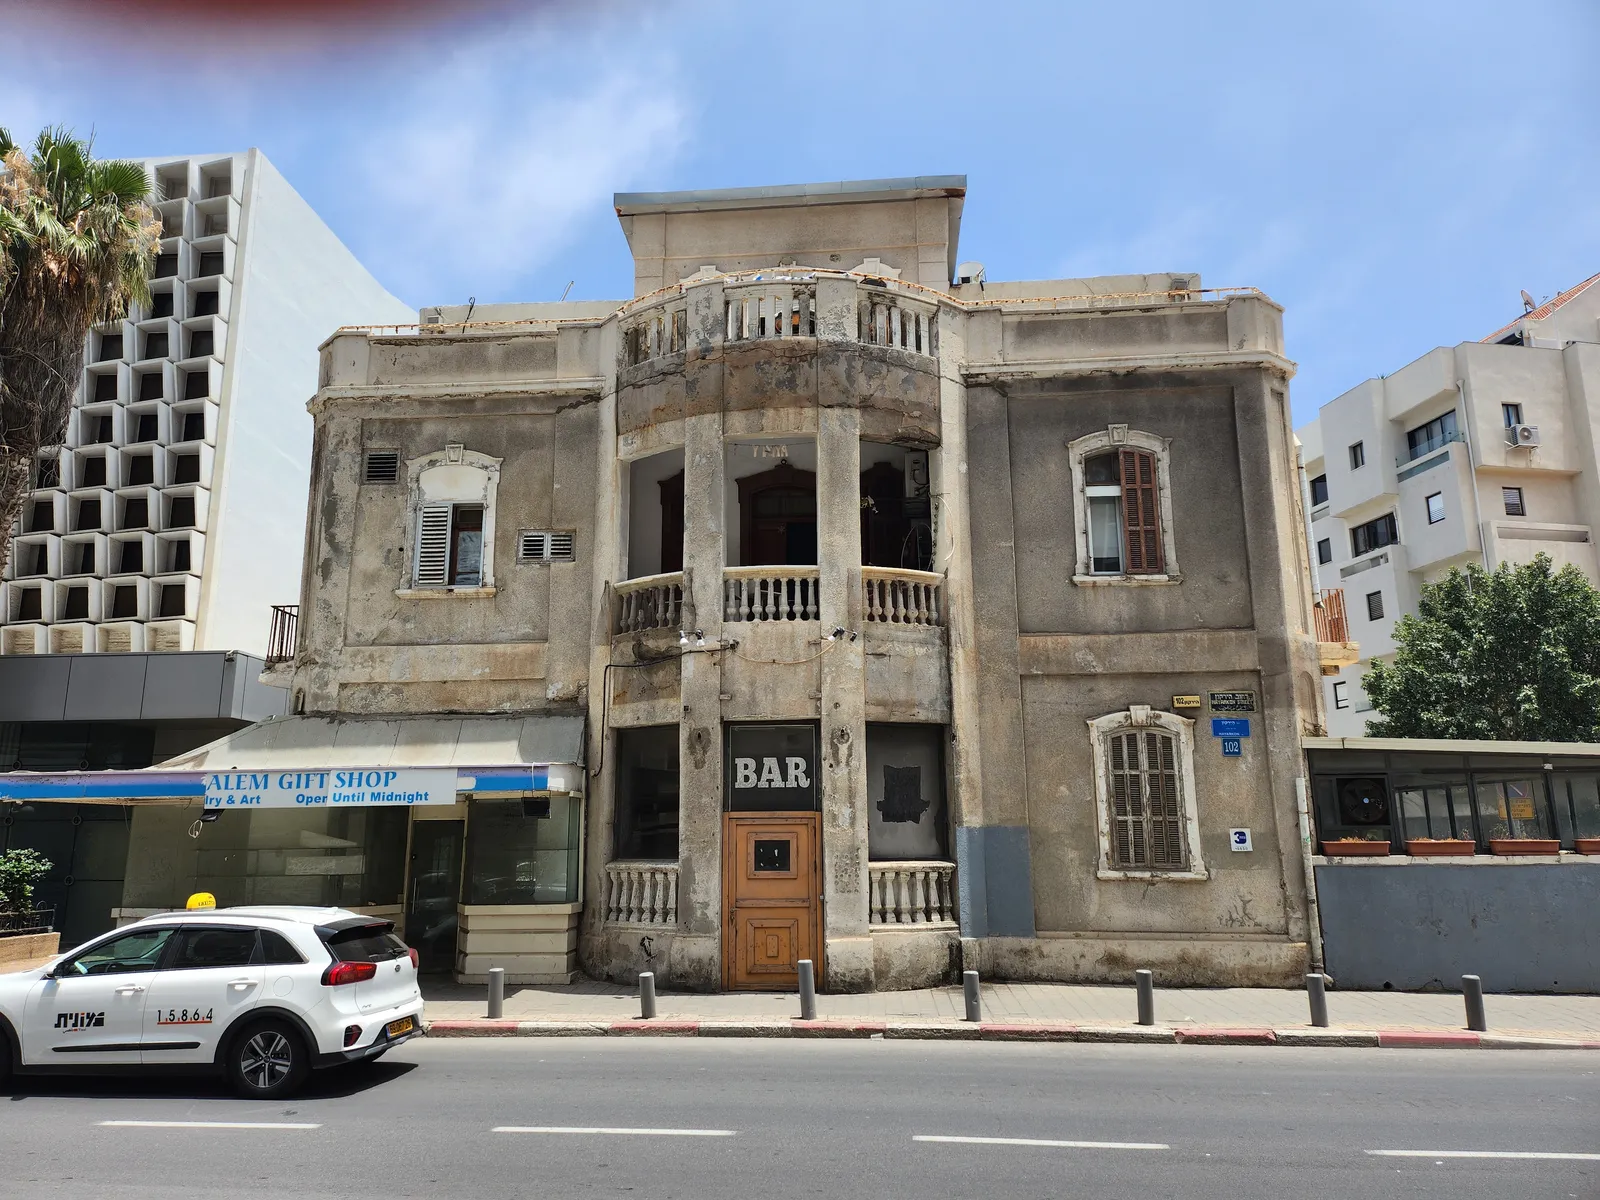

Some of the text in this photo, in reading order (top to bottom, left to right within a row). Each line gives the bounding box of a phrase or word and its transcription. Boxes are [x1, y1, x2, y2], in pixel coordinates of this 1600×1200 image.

[1224, 741, 1239, 753] 102
[206, 771, 397, 791] ALEM GIFT SHOP
[734, 756, 811, 789] BAR
[226, 795, 236, 805] &
[240, 794, 261, 805] Art
[332, 792, 365, 803] Until
[370, 791, 430, 804] Midnight
